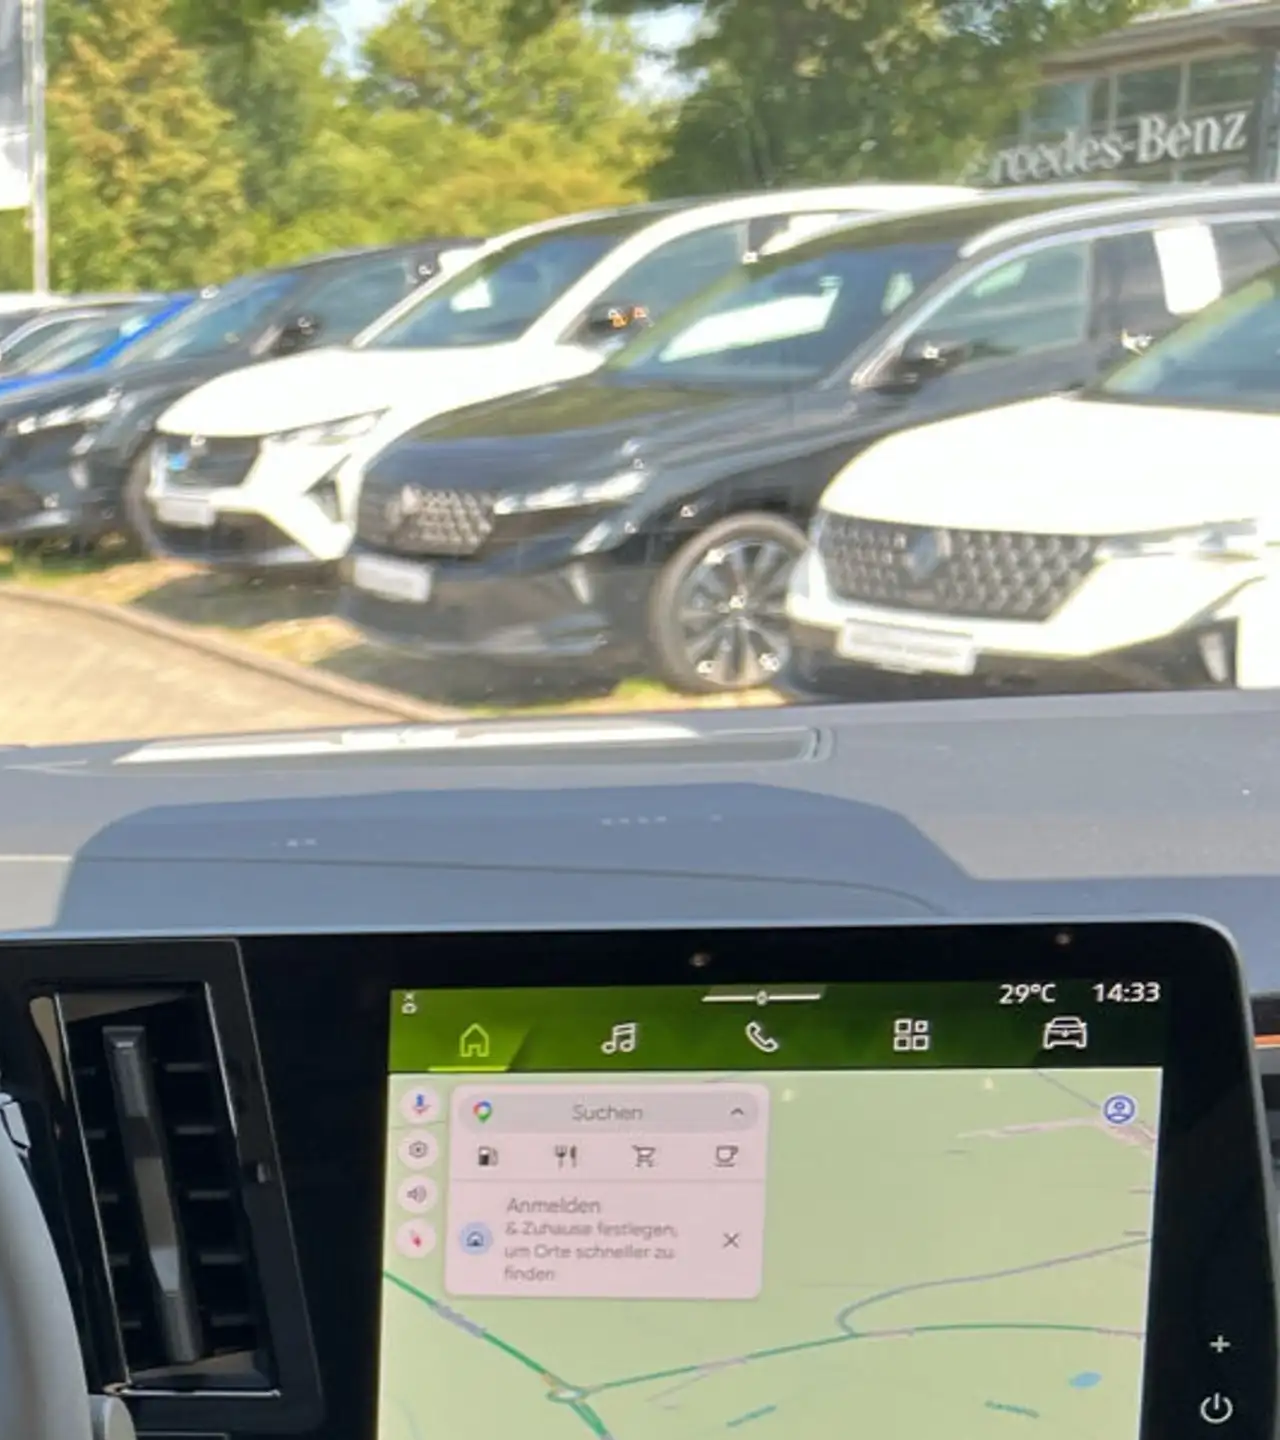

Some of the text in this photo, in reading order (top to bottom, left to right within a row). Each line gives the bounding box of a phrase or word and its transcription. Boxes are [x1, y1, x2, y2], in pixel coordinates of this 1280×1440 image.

[970, 110, 1248, 185] rcedes-Benz
[999, 983, 1057, 1004] 29°C
[1092, 981, 1161, 1003] 14:33
[571, 1104, 643, 1122] Suchen
[507, 1197, 601, 1214] Anmelden
[523, 1220, 592, 1236] Zuhause
[504, 1243, 675, 1259] um Orte schneller zu
[504, 1266, 555, 1281] finden
